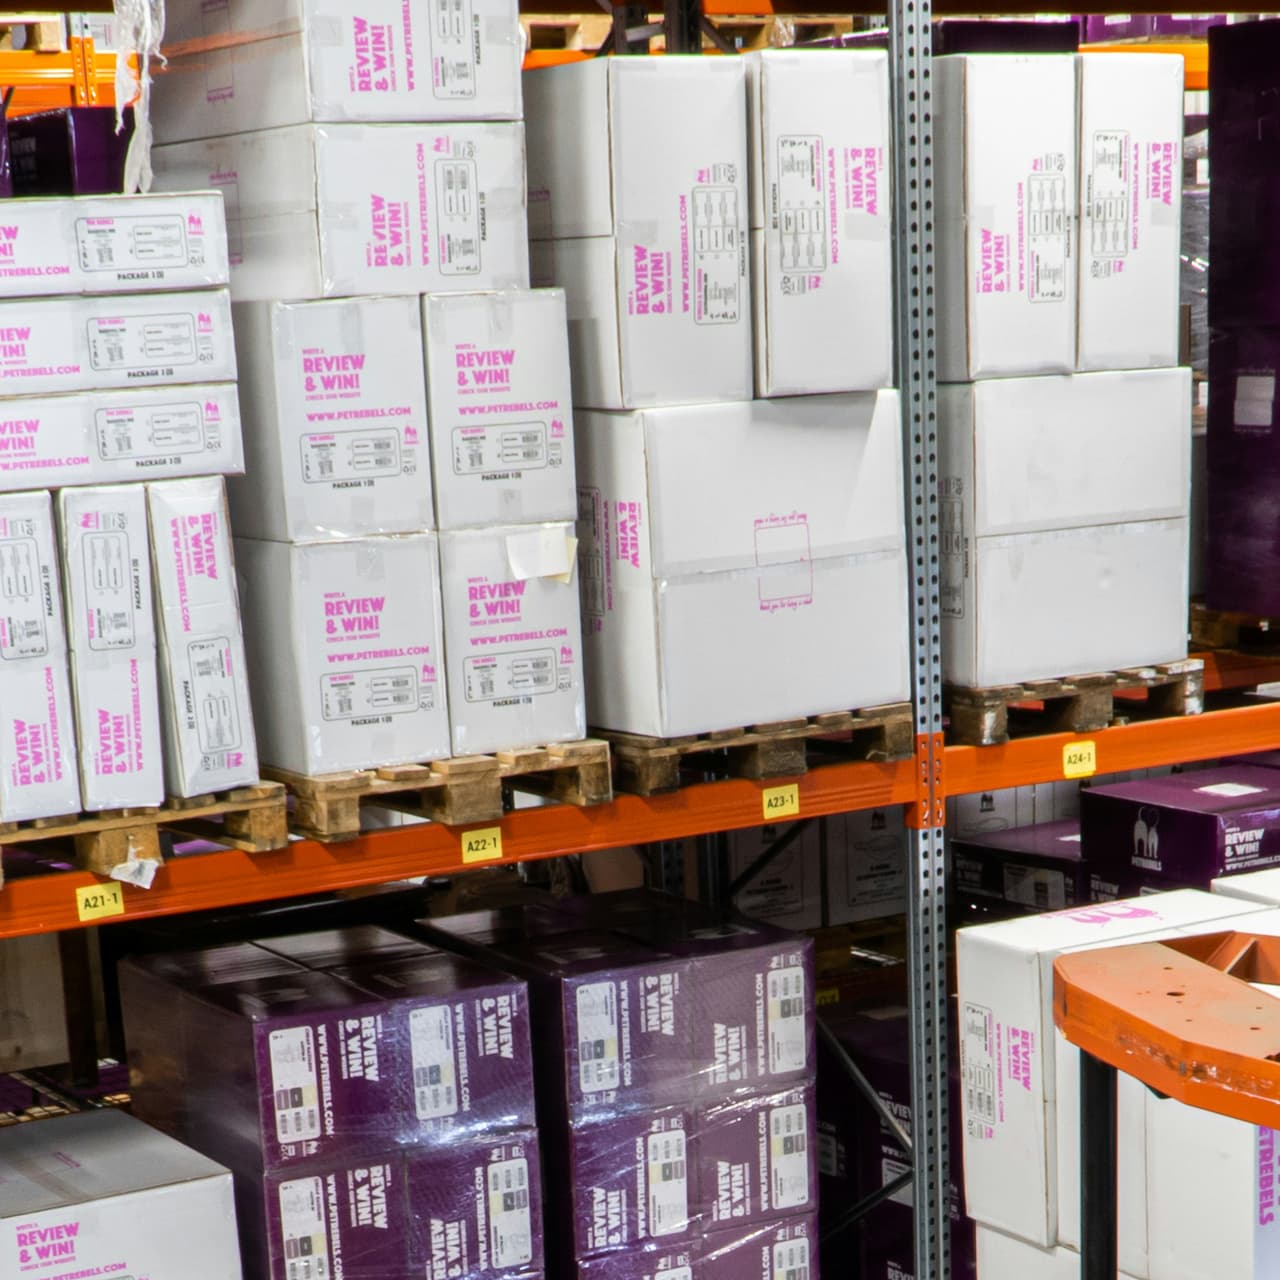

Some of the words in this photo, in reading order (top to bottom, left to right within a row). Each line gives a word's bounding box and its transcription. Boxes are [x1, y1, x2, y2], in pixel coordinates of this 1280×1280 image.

[353, 16, 372, 92] REVIEW
[374, 24, 387, 74] WIN!
[376, 77, 389, 91] &
[851, 148, 862, 160] &
[864, 148, 877, 216] REVIEW
[1163, 143, 1172, 205] REVIEW
[851, 166, 863, 208] WIN!
[417, 143, 429, 266] WWW.PETREBELS.COM
[371, 194, 388, 267] REVIEW
[387, 202, 402, 247] WIN!
[391, 252, 404, 267] &
[981, 229, 992, 293] REVIEW
[118, 272, 148, 280] PACKAGE
[634, 244, 649, 314] REVIEW
[650, 252, 664, 295] WIN!
[652, 301, 664, 313] &
[303, 354, 365, 374] REVIEW
[456, 350, 515, 369] REVIEW
[304, 376, 316, 392] &
[319, 374, 360, 390] WIN!
[457, 371, 468, 387] &
[471, 369, 510, 385] WIN!
[307, 407, 412, 422] WWW.PETREBELS.COM
[459, 401, 558, 416] WWW.PETREBELS.COM
[136, 459, 166, 468] PACKAGE
[618, 502, 627, 513] &
[188, 515, 200, 526] &
[619, 517, 630, 560] WIN!
[627, 502, 640, 568] REVIEW
[191, 533, 205, 576] WIN!
[201, 513, 218, 579] REVIEW
[469, 580, 526, 600] REVIEW
[324, 597, 385, 617] REVIEW
[469, 602, 480, 618] &
[484, 600, 521, 615] WIN!
[326, 619, 338, 635] &
[340, 615, 380, 632] WIN!
[470, 628, 568, 645] WWW.PETREBELS.COM
[327, 646, 429, 663] WWW.PETREBELS.COM
[29, 725, 43, 764] WIN!
[98, 709, 113, 775] REVIEW
[113, 716, 126, 758] WIN!
[13, 719, 32, 786] REVIEW
[1067, 751, 1092, 765] A24-1
[33, 771, 45, 783] &
[115, 762, 127, 772] &
[766, 794, 795, 809] A23-1
[467, 836, 497, 852] A22-1
[1225, 828, 1265, 844] REVIEW
[1225, 844, 1234, 857] &
[1236, 841, 1260, 856] WIN!
[83, 892, 119, 910] A21-1
[660, 973, 675, 1036] REVIEW
[345, 1019, 360, 1032] &
[497, 994, 514, 1059] REVIEW
[1011, 1028, 1020, 1038] &
[361, 1016, 380, 1082] REVIEW
[1012, 1044, 1021, 1080] WIN!
[1020, 1030, 1031, 1091] REVIEW
[354, 1168, 369, 1182] &
[1259, 1126, 1274, 1225] ETREBELS
[370, 1165, 388, 1229] REVIEW
[17, 1223, 79, 1247] REVIEW
[20, 1249, 31, 1263] &
[35, 1240, 75, 1259] WIN!
